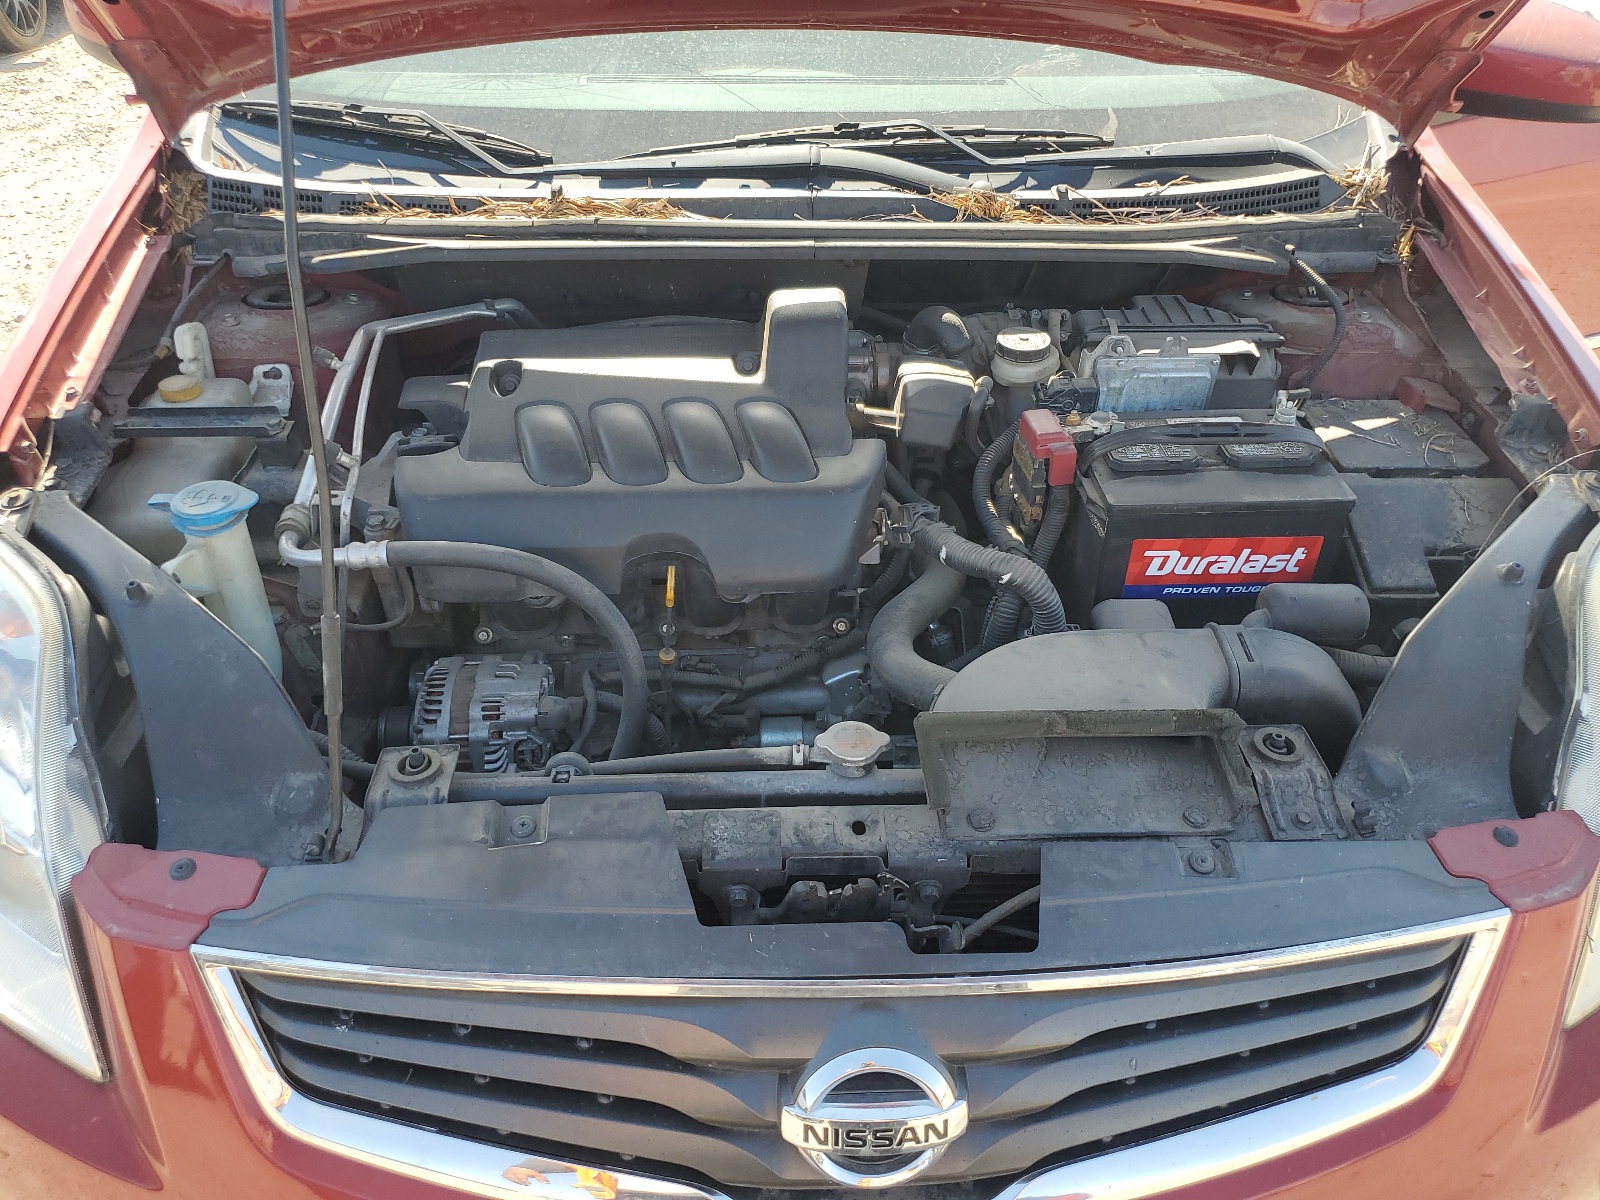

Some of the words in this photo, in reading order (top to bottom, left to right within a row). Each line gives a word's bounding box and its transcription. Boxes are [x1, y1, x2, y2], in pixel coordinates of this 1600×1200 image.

[1143, 547, 1307, 576] Duralast
[1162, 586, 1221, 595] PROVEN
[1225, 585, 1266, 594] TOUG
[802, 1118, 949, 1150] NISSAN
